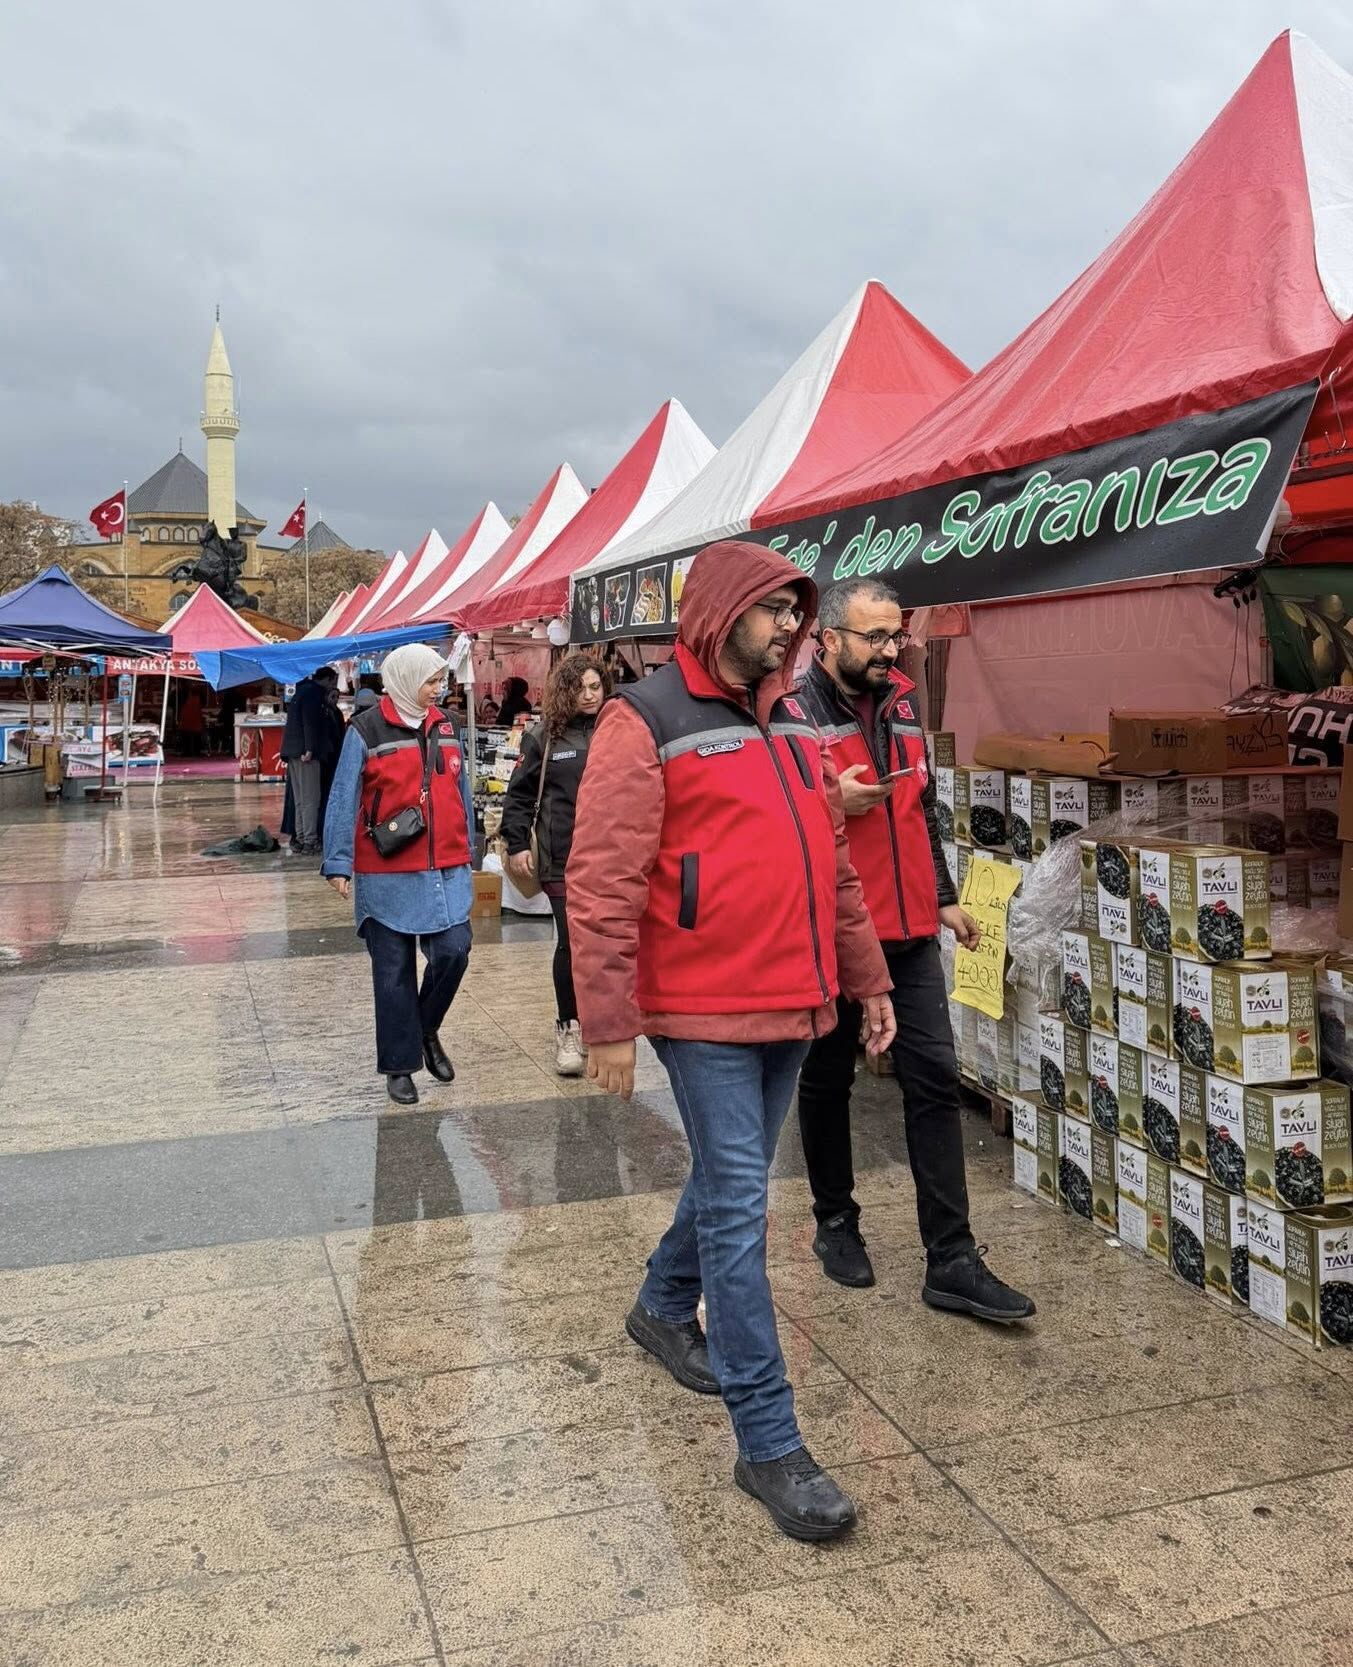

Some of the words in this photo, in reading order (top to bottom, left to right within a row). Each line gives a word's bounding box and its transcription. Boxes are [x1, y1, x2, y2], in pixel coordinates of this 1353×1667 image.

[832, 515, 923, 581] den
[975, 788, 1001, 797] TAVLI
[1191, 797, 1218, 805] TAVLI
[1055, 802, 1084, 810] TAVLI
[963, 860, 995, 906] 10
[1143, 874, 1166, 887] TAVLI
[1203, 881, 1238, 892] TAVLI
[1102, 906, 1127, 920] TAVLI
[1066, 953, 1088, 967] TAVLI
[958, 958, 998, 992] 4000
[1120, 967, 1143, 982] TAVLI
[1183, 985, 1208, 1002] TAVLI
[1246, 998, 1282, 1011] TAVLI
[1041, 1036, 1062, 1051] TAVLI
[1093, 1054, 1114, 1072] TAVLI
[1151, 1076, 1176, 1095] TAVLI
[1210, 1102, 1239, 1121] TAVLI
[1014, 1116, 1034, 1133] TAVLI
[1281, 1120, 1316, 1134] TAVLI
[1067, 1139, 1089, 1157] TAVLI
[1120, 1165, 1143, 1185] TAVLI
[1173, 1195, 1200, 1217] TAVLI
[1250, 1226, 1280, 1250] TAVLI
